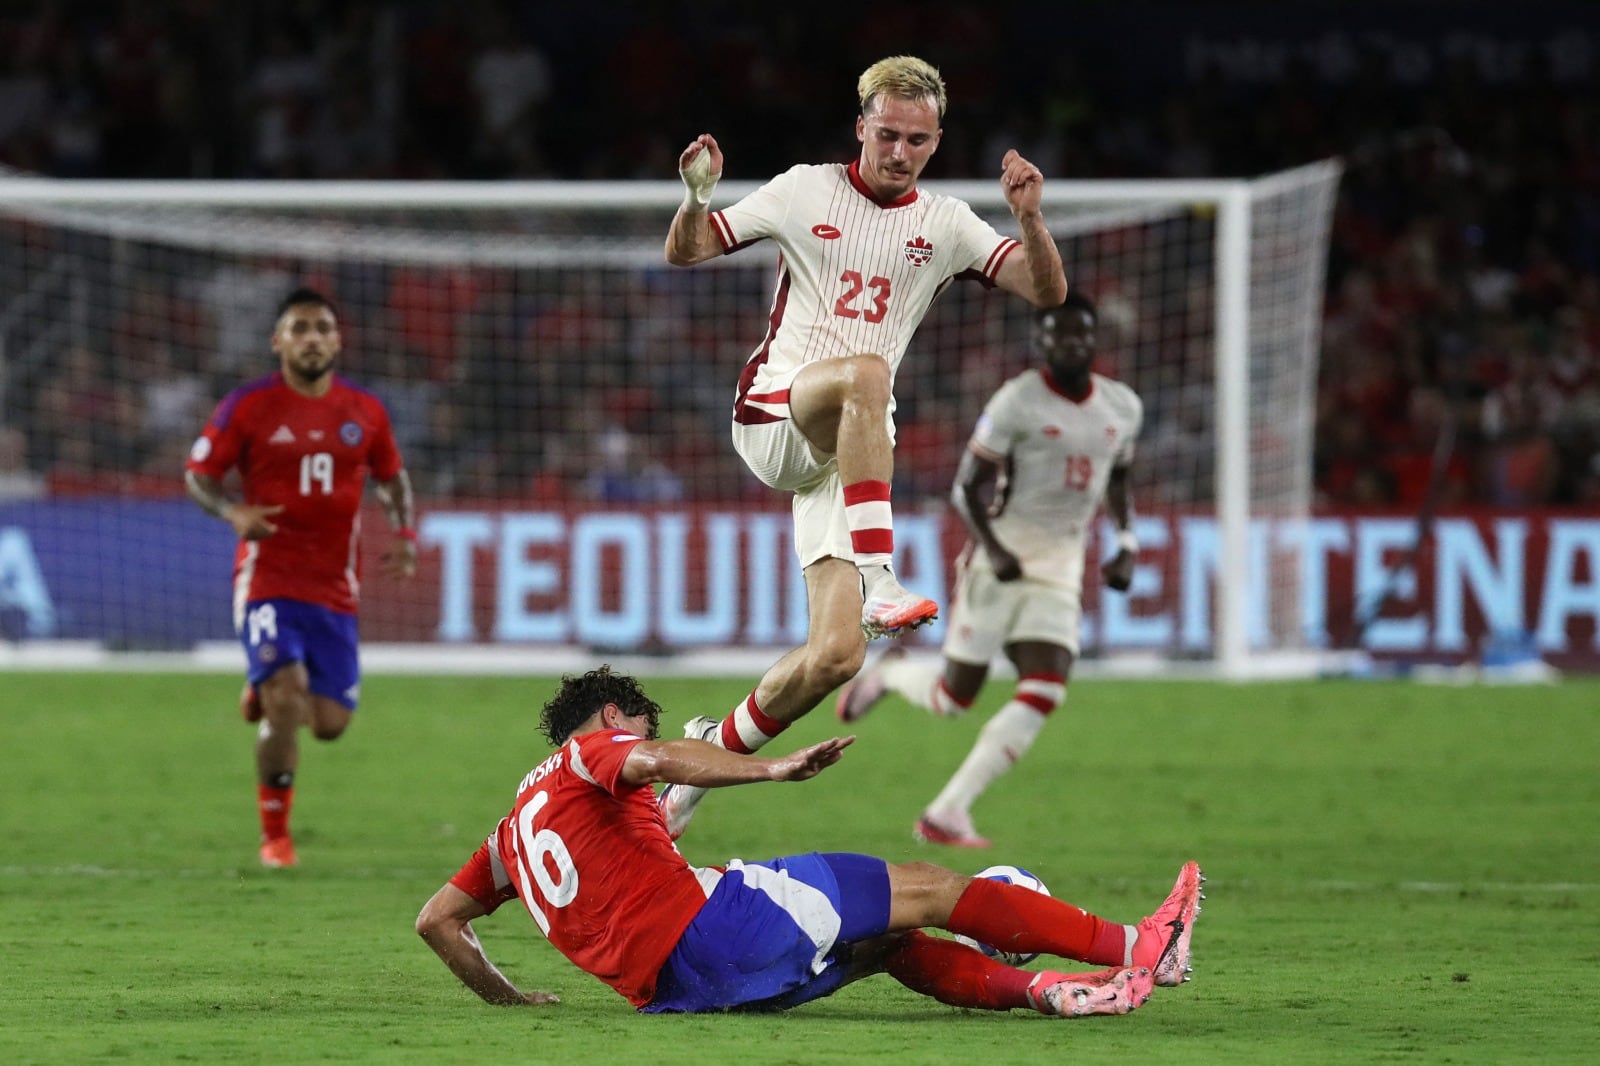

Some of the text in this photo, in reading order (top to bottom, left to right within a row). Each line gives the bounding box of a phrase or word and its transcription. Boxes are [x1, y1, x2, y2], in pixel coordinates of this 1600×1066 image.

[904, 247, 932, 256] CANADA
[834, 269, 891, 324] 23
[300, 452, 334, 496] 19
[1080, 514, 1600, 652] ENTENA
[249, 603, 277, 645] 19
[509, 790, 579, 938] 16
